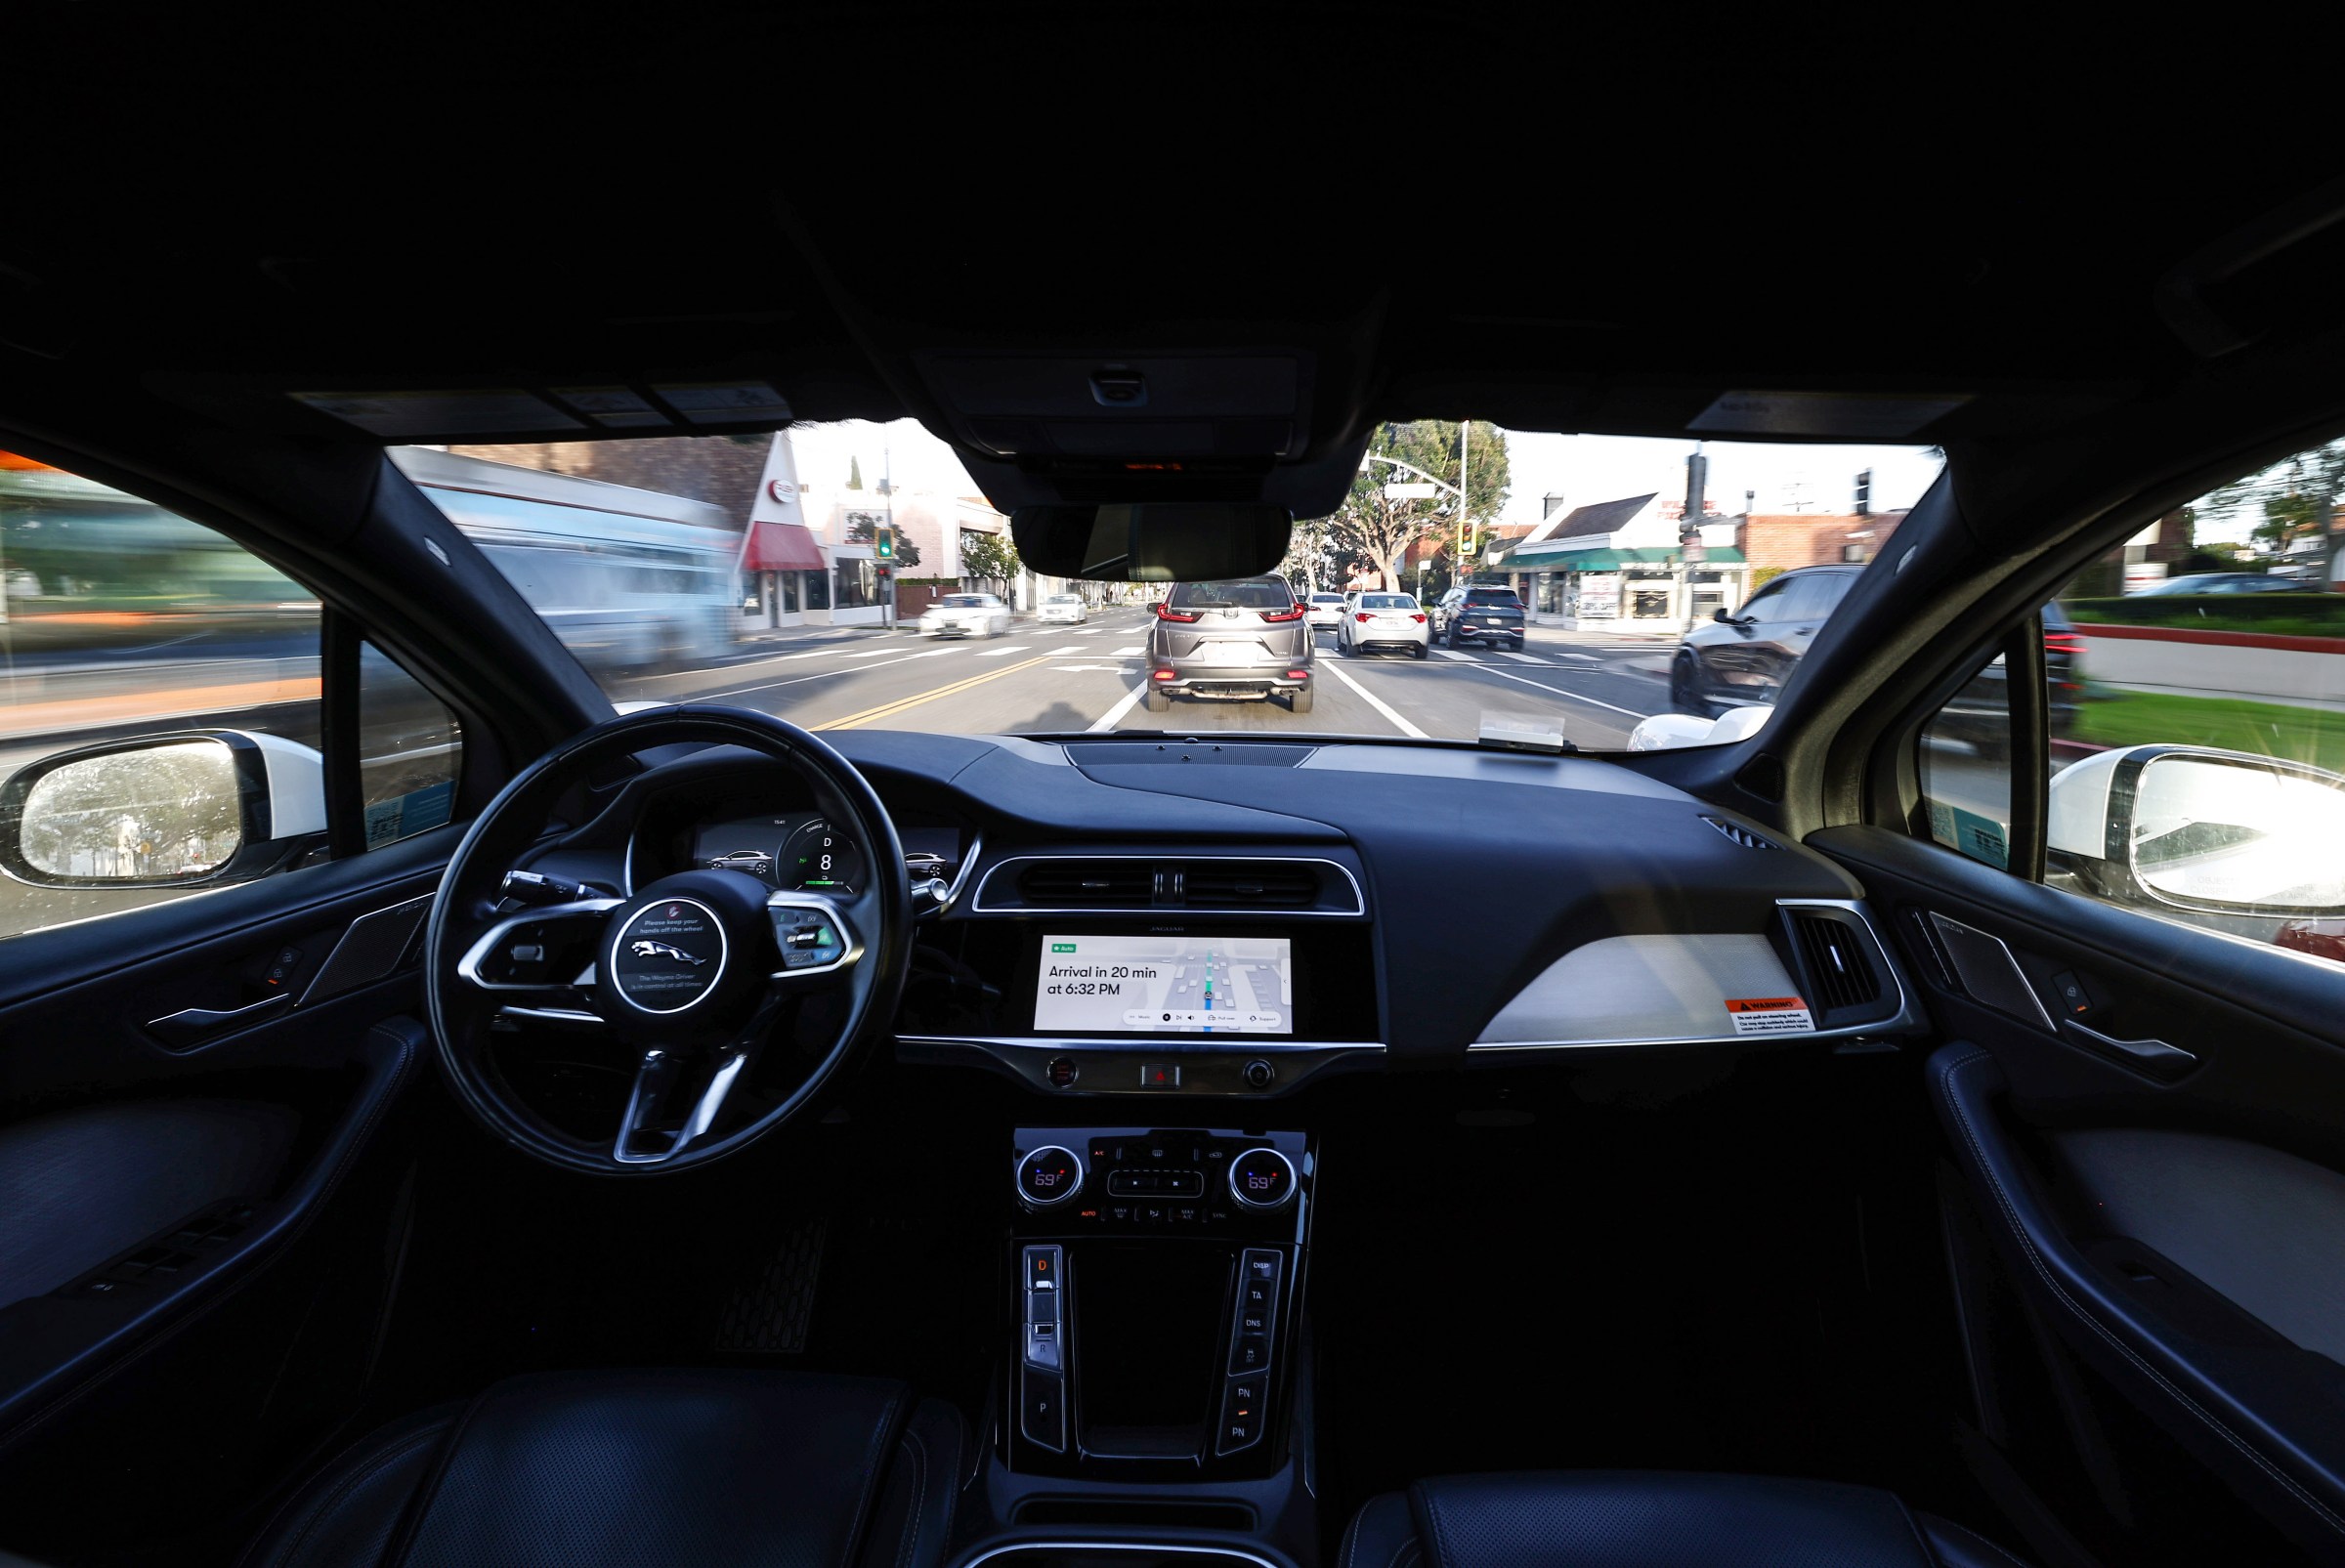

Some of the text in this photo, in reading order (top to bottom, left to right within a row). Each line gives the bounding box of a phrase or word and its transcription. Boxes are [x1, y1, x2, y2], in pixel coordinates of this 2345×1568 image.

[823, 837, 832, 847] D
[820, 854, 832, 870] 8
[1048, 965, 1157, 979] Arrival in 20 min
[1046, 983, 1121, 996] at 6:32 PM
[1080, 1209, 1097, 1218] AUTO
[1211, 1211, 1228, 1220] SYNC
[1038, 1259, 1048, 1271] D
[1252, 1261, 1270, 1270] DISP
[1251, 1291, 1263, 1301] TA
[1245, 1318, 1262, 1329] DNS
[1040, 1343, 1046, 1354] R
[1039, 1402, 1047, 1414] P
